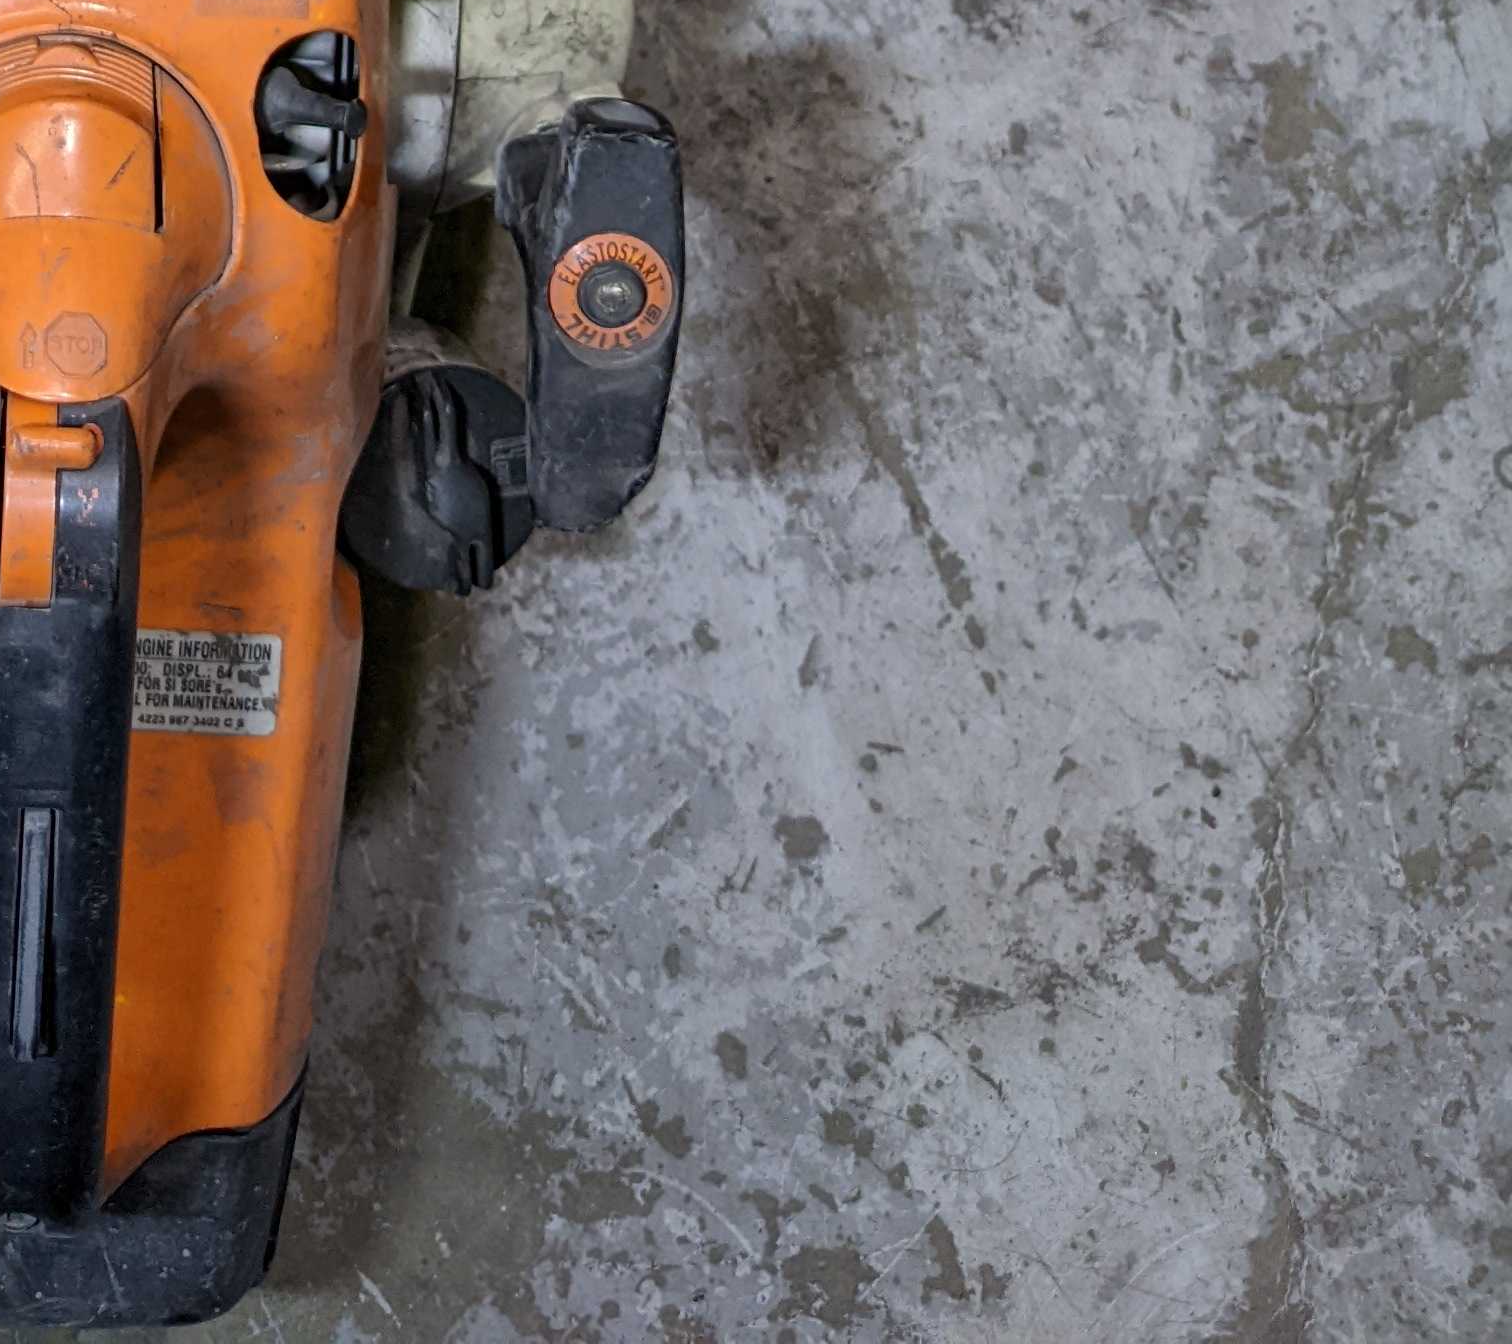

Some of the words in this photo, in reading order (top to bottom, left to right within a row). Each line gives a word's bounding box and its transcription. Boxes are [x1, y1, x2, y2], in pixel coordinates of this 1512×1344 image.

[566, 312, 642, 349] STIHL
[136, 639, 173, 657] NGINE
[137, 676, 160, 690] FOR
[146, 693, 169, 707] FOR
